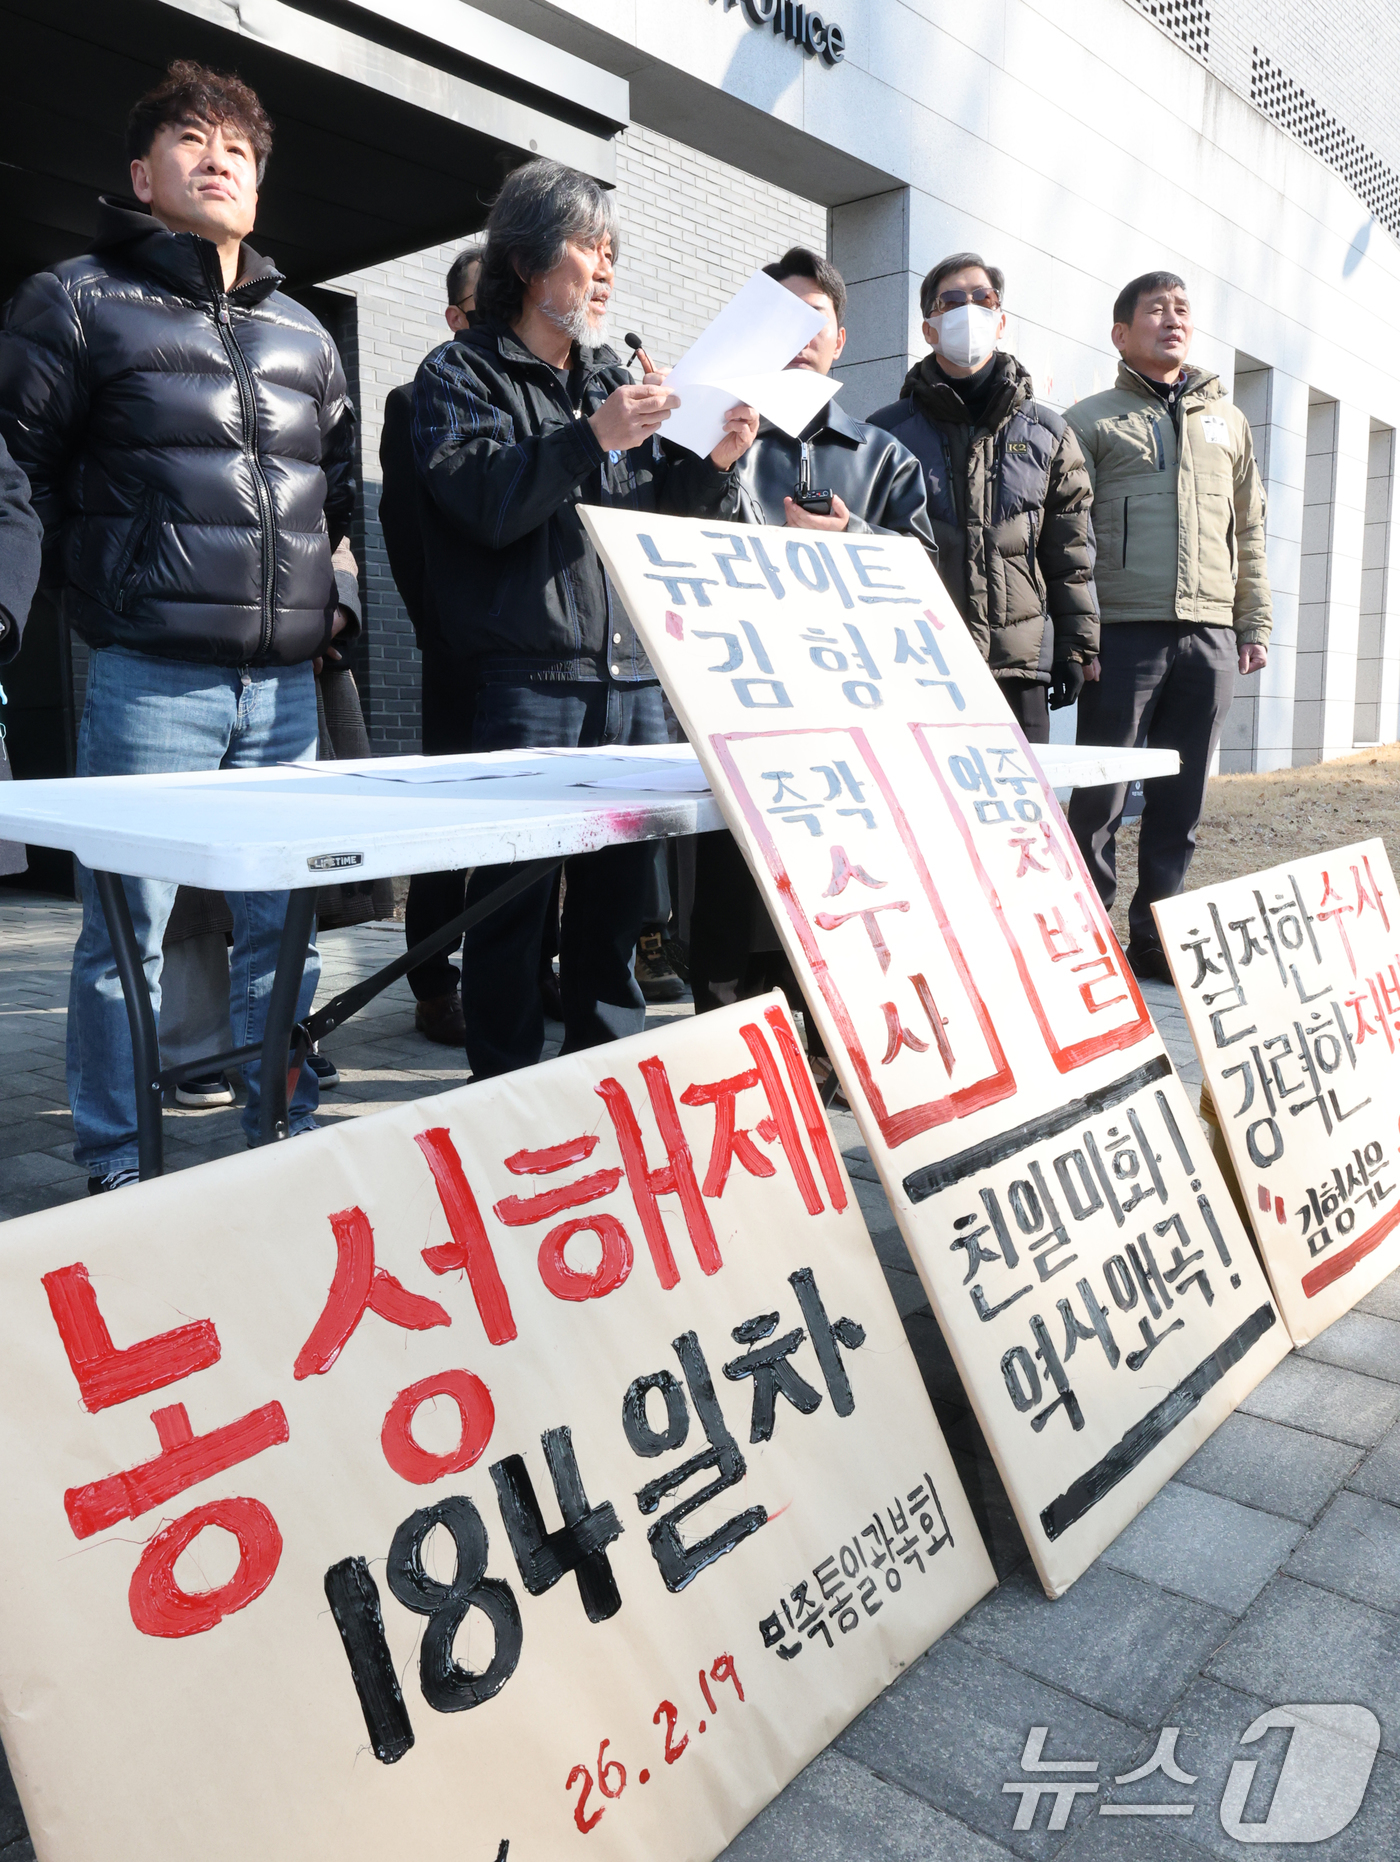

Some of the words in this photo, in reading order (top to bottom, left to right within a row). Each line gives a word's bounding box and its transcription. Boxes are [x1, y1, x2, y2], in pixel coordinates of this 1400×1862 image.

[1008, 443, 1027, 452] K2
[636, 530, 922, 609] 뉴라이트
[761, 760, 878, 837] 즉각
[948, 745, 1038, 825] 엄중
[813, 845, 957, 1080] 수사
[1007, 820, 1129, 1014] 처벌
[1180, 875, 1333, 1048] 철저한
[1316, 854, 1390, 980] 수사
[1221, 1001, 1372, 1168] 강력한
[950, 1089, 1202, 1322] 친일미화!
[41, 1005, 849, 1639] 농성해제
[1000, 1193, 1242, 1433] 역사왜곡!
[323, 1266, 867, 1765] 184일차
[759, 1472, 955, 1661] 민족통일광복회
